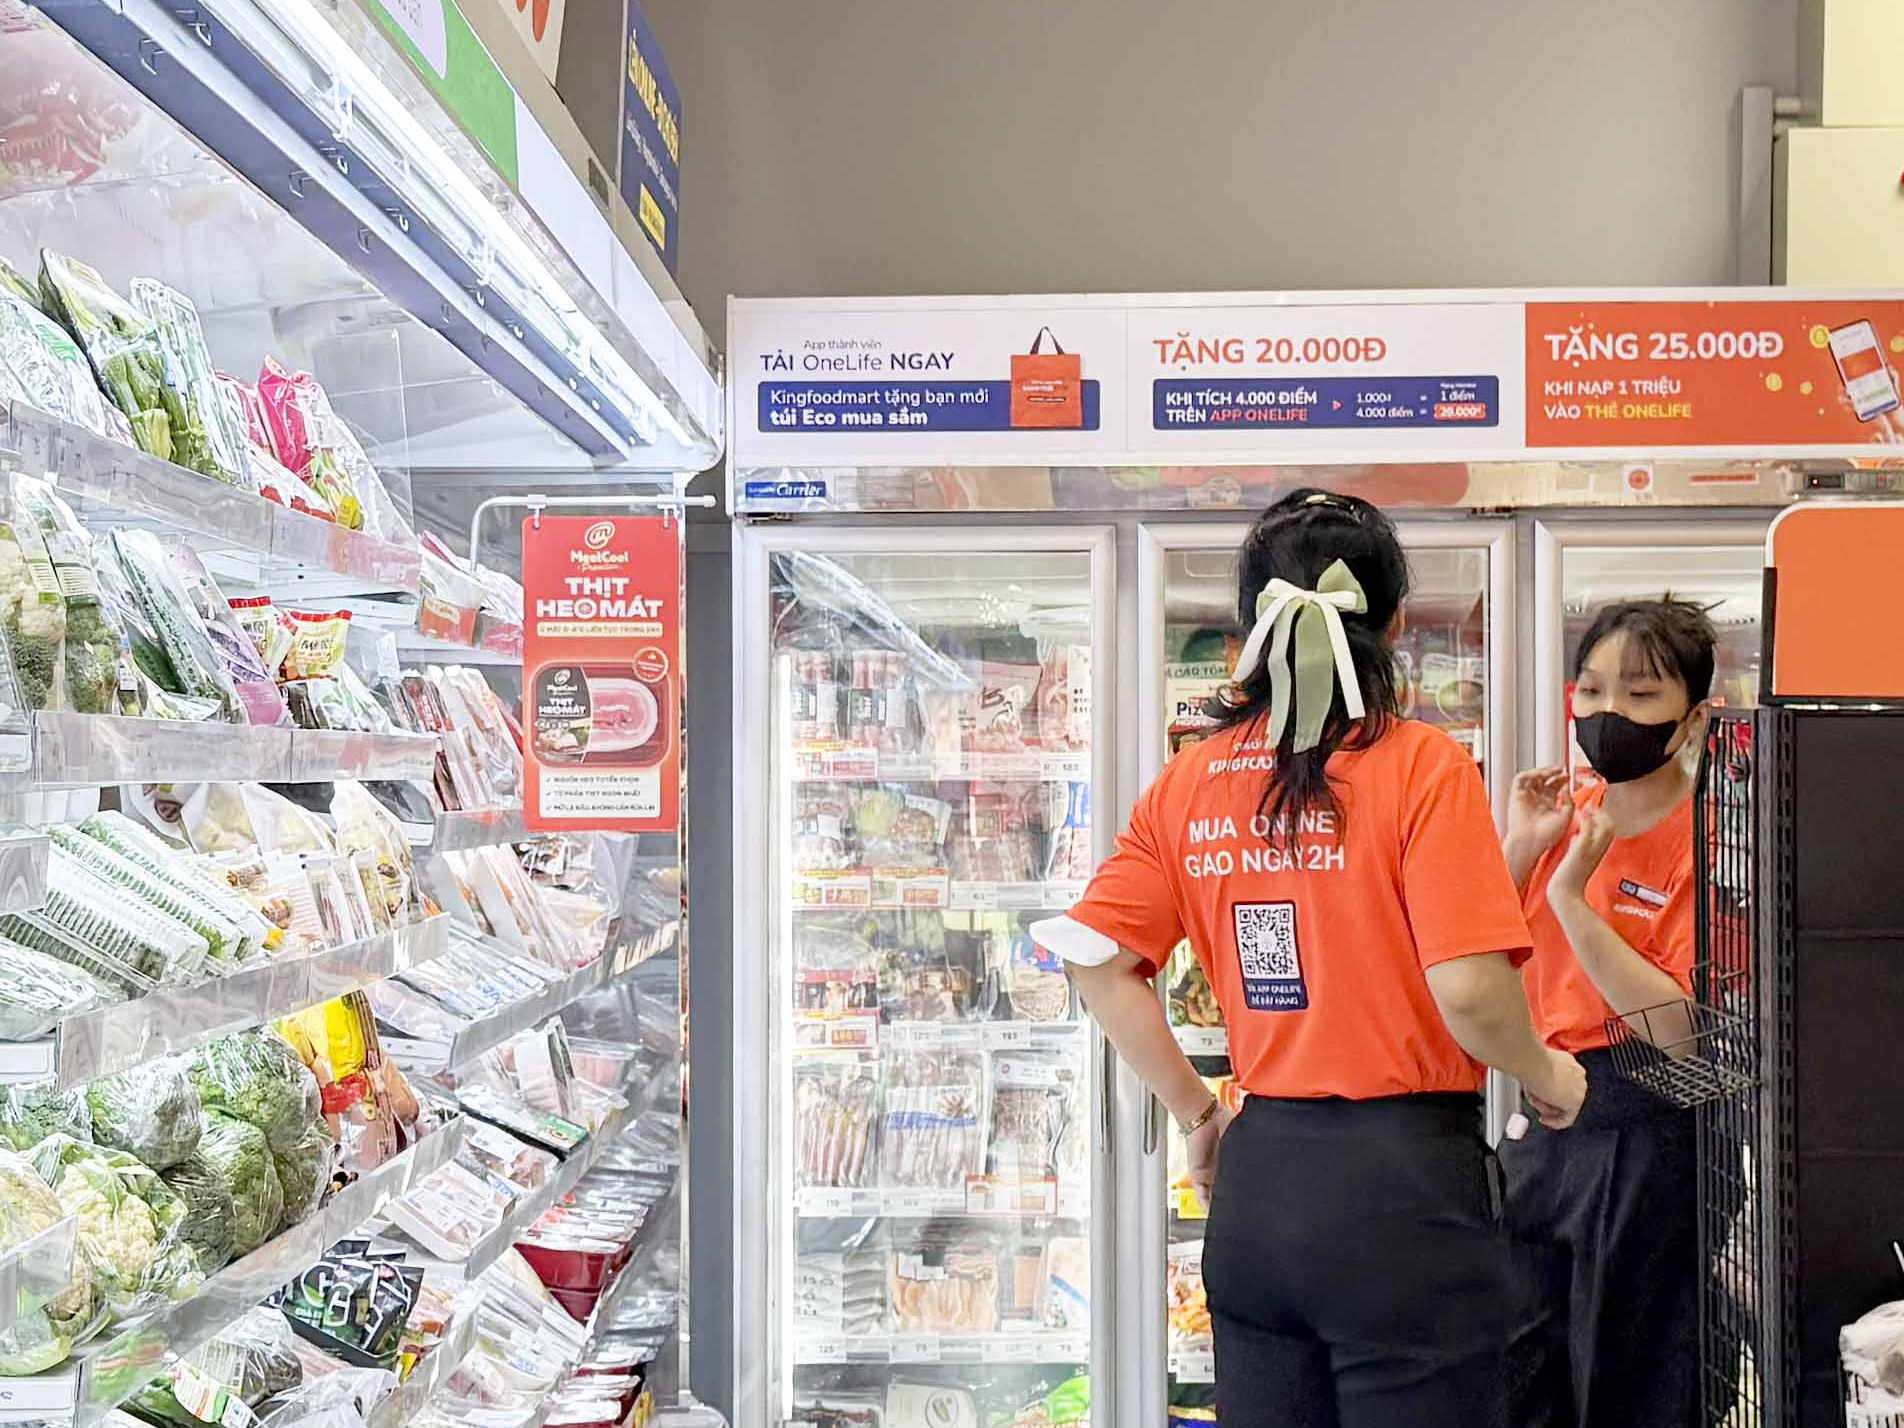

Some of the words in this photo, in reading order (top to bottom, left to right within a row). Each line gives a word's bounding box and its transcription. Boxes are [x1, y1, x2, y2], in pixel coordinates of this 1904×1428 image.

[803, 339, 825, 351] App
[827, 338, 855, 350] thành
[856, 338, 883, 350] viên
[1152, 332, 1246, 372] TẶNG
[1255, 336, 1387, 365] 20.000Đ
[1544, 326, 1640, 368] TẶNG
[1649, 331, 1784, 360] 25.000Đ
[758, 348, 795, 372] TẢI
[802, 352, 883, 372] OneLife
[890, 353, 955, 371] NGAY
[1165, 391, 1193, 406] KHI
[1195, 387, 1233, 406] TÍCH
[1235, 391, 1276, 406] 4.000
[1278, 387, 1318, 406] ĐIỂM
[1544, 380, 1573, 396] KHI
[1577, 380, 1613, 399] NẠP
[1618, 381, 1628, 395] 1
[1632, 376, 1681, 398] TRIỆU
[770, 388, 882, 409] Kingfoodmart
[884, 389, 921, 410] tặng
[924, 389, 957, 409] bạn
[959, 388, 990, 405] mới
[769, 407, 798, 425] túi
[802, 409, 837, 425] Eco
[841, 410, 884, 425] mua
[887, 405, 929, 425] sắm
[1165, 405, 1207, 423] TRÊN
[1209, 408, 1243, 422] APP
[1246, 408, 1309, 423] ONELIFE
[1355, 407, 1387, 419] 4.000
[1544, 401, 1581, 420] VÀO
[1621, 403, 1693, 420] ONELIFE
[777, 483, 823, 498] Carrier
[564, 576, 631, 599] THỊT
[536, 599, 598, 620] HEO
[599, 593, 664, 619] MÁT
[1189, 814, 1238, 844] MUA
[1249, 810, 1336, 841] ONNE
[1306, 844, 1345, 871] 2H
